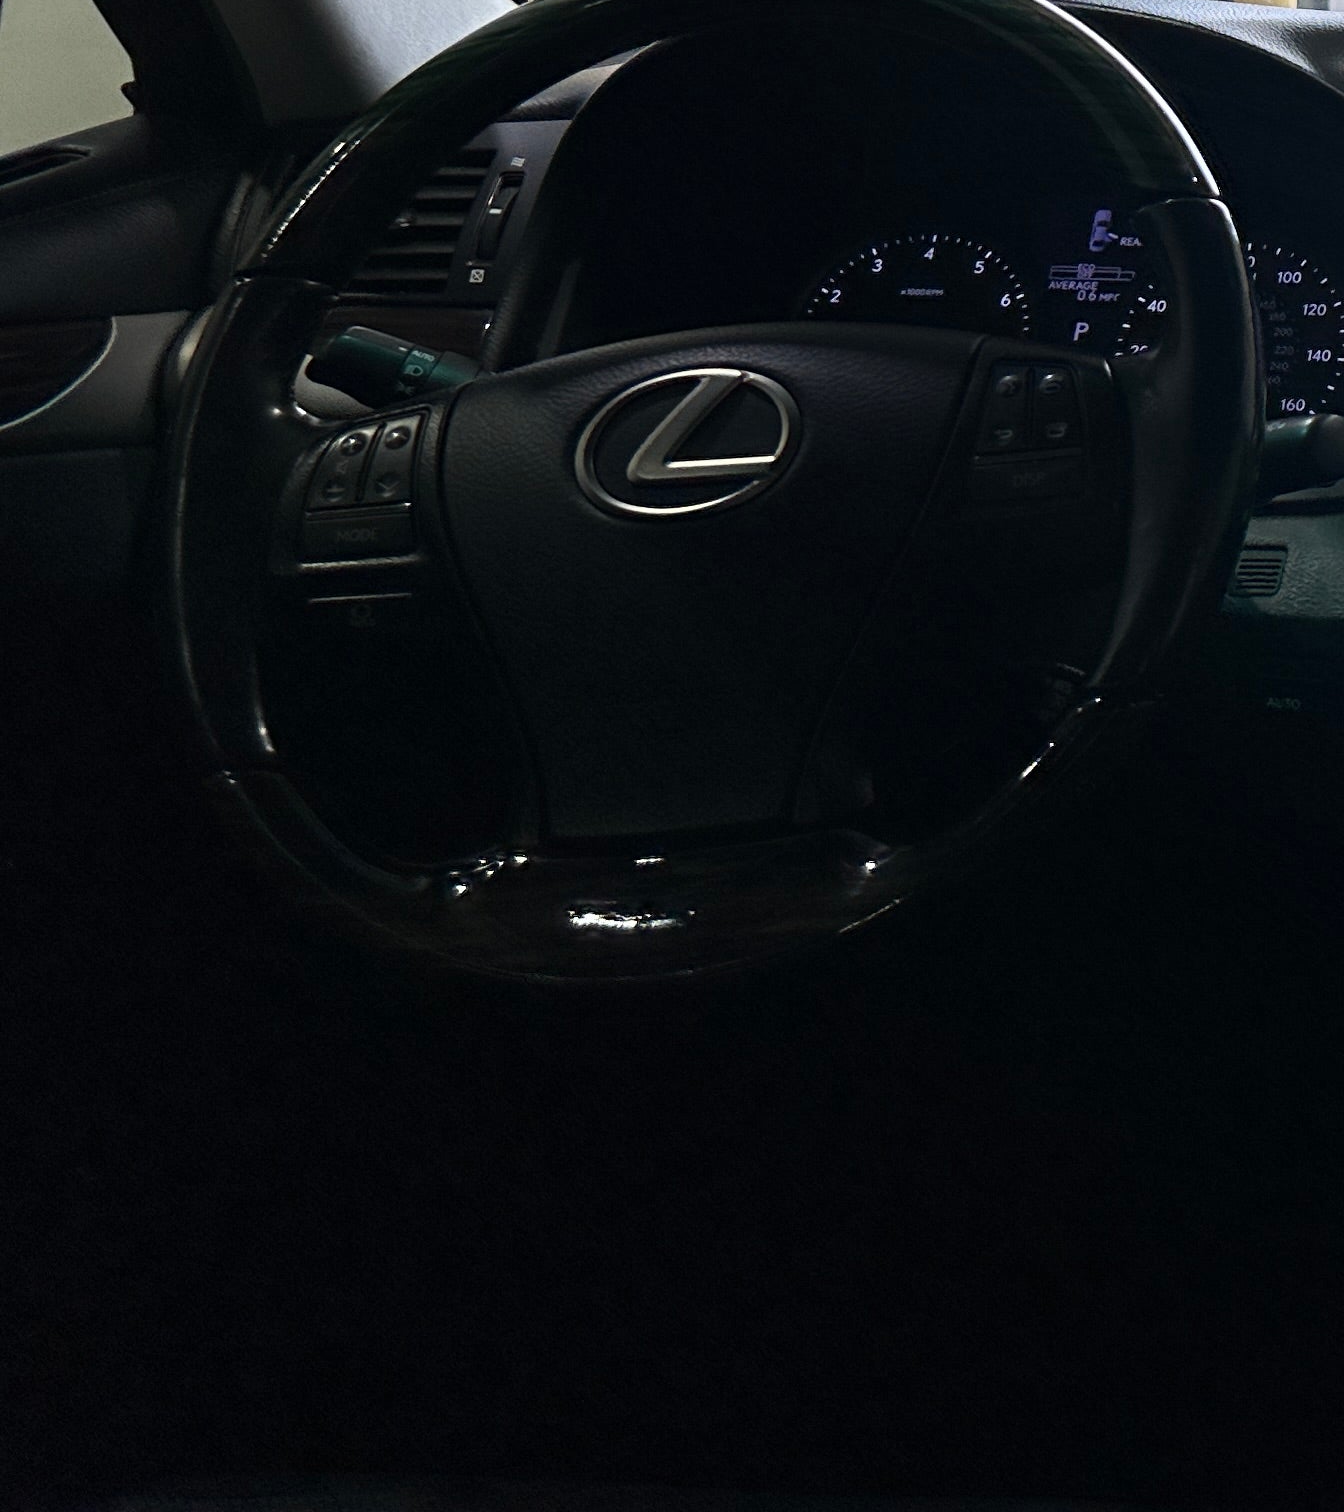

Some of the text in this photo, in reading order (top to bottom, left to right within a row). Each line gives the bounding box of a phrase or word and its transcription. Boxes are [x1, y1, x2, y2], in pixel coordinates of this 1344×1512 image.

[1119, 237, 1144, 247] REA
[924, 247, 935, 261] 4
[871, 259, 883, 273] 3
[973, 261, 985, 275] 5
[1277, 271, 1303, 284] 100
[1048, 281, 1100, 292] AVERAGE
[829, 289, 842, 303] 2
[1000, 293, 1012, 308] 6
[1146, 299, 1168, 313] 40
[1302, 303, 1328, 317] 120
[1073, 321, 1090, 341] P
[1307, 349, 1332, 363] 140
[1280, 398, 1306, 412] 160
[336, 530, 380, 543] MODE
